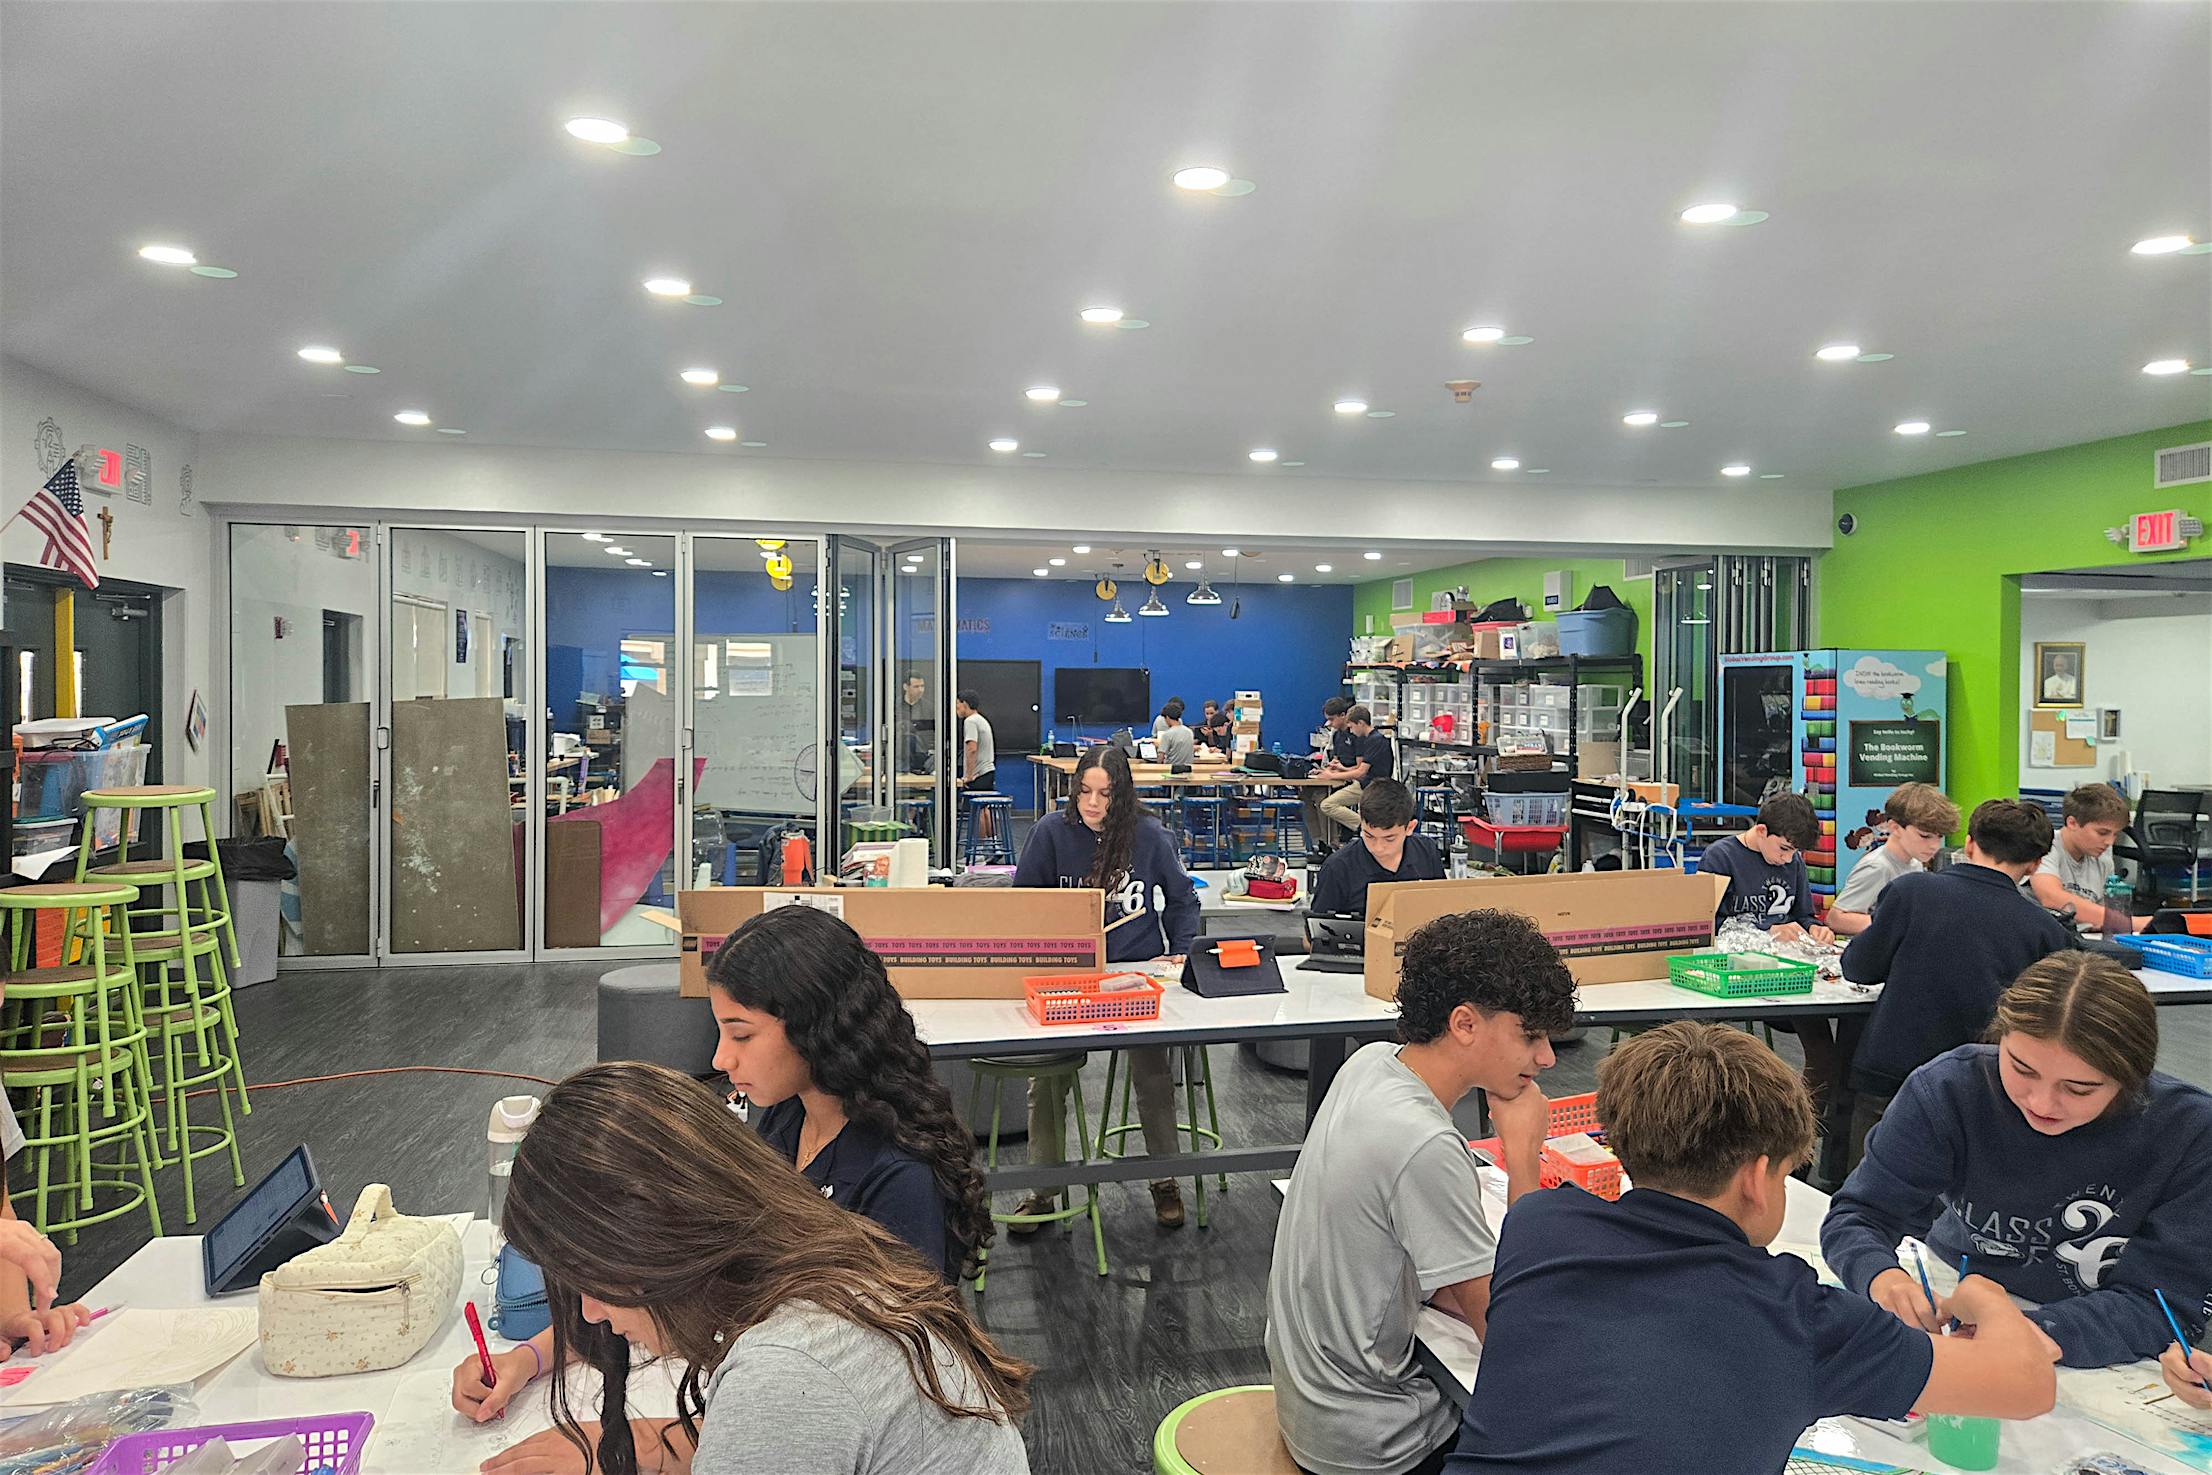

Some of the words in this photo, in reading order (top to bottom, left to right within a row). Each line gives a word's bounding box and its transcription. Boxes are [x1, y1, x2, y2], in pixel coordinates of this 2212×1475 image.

[2136, 512, 2175, 547] EXIT
[1864, 743, 1879, 751] The
[1881, 743, 1924, 751] Bookworm
[1859, 753, 1892, 763] Vending
[1894, 753, 1928, 761] Machine
[1732, 895, 1767, 913] LASS
